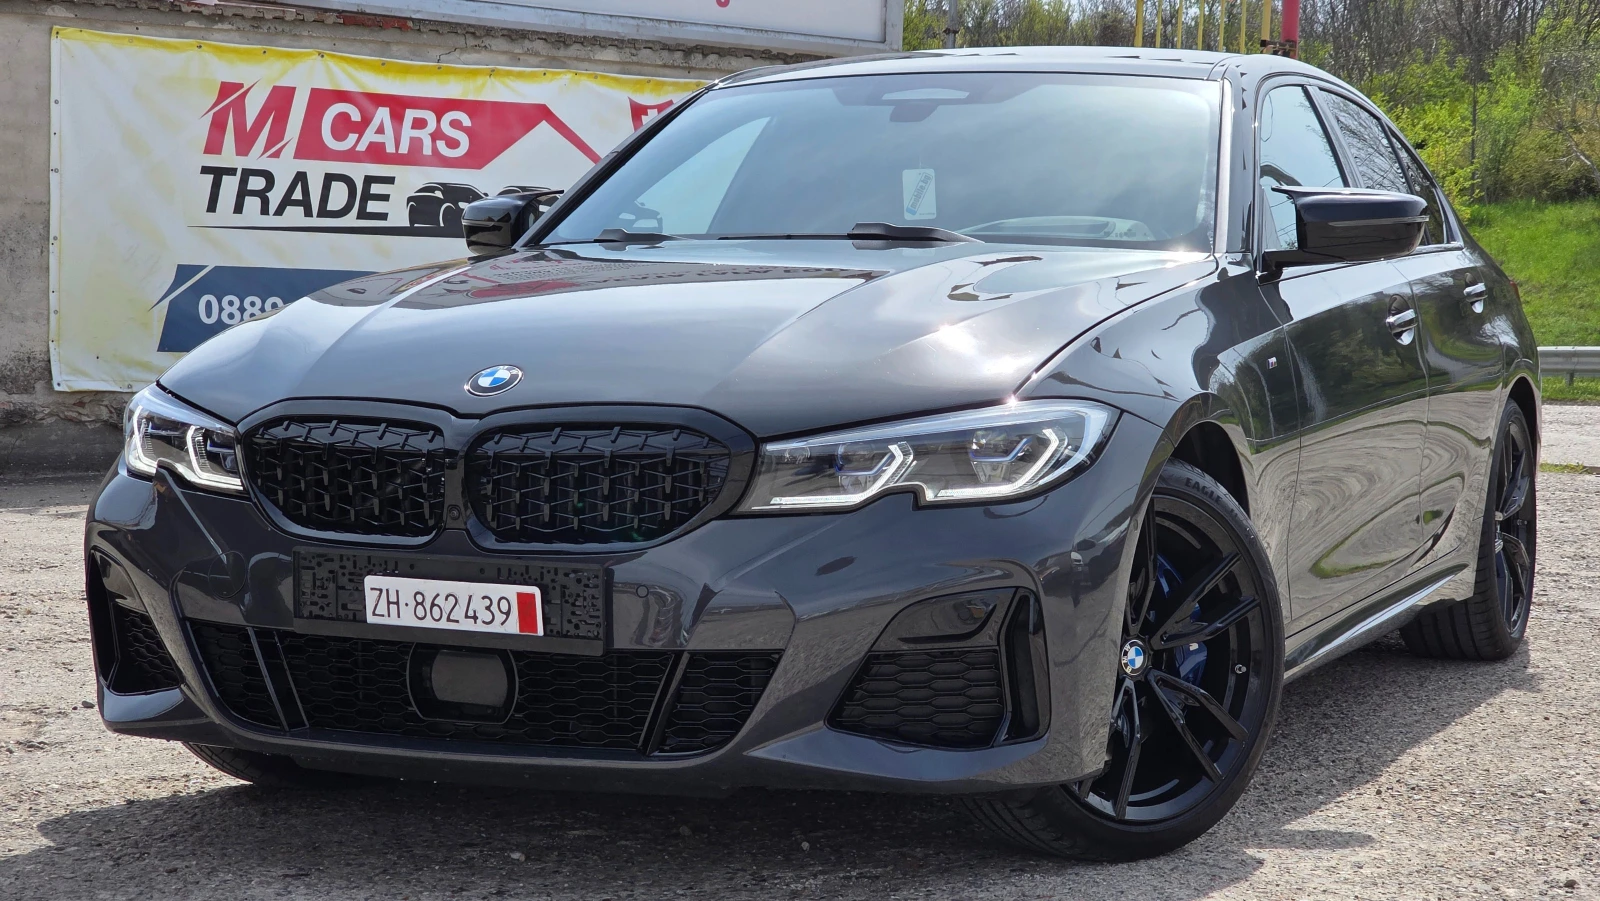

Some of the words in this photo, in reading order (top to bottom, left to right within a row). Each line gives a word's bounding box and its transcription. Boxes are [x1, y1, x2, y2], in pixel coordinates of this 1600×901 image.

[200, 78, 297, 160] M
[321, 102, 472, 158] CARS
[200, 165, 396, 221] TRADE
[1185, 477, 1223, 504] EAGLE
